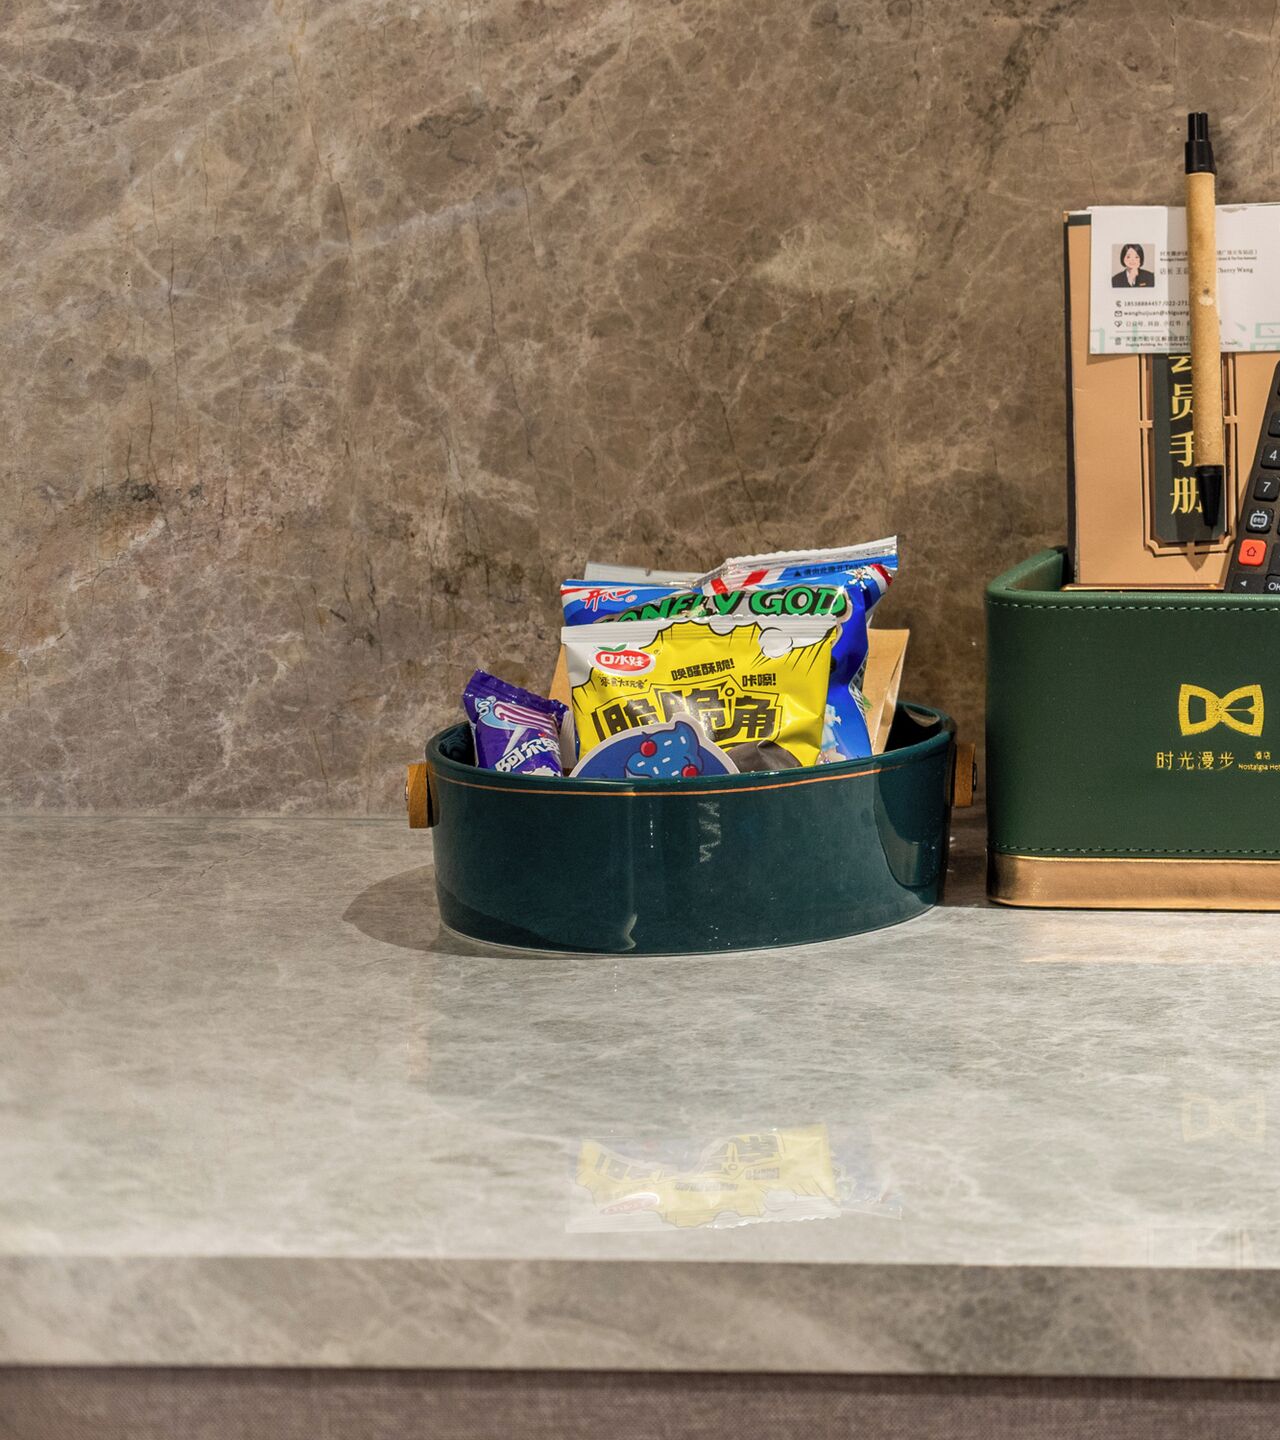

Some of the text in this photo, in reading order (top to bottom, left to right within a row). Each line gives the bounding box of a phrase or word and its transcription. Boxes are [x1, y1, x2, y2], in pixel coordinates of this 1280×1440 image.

[1269, 450, 1277, 461] 4
[1263, 482, 1271, 493] 7
[750, 587, 848, 616] GOD
[600, 653, 645, 667] 口水娃
[1156, 751, 1234, 771] 时光漫步
[1238, 763, 1268, 772] Nostalgia
